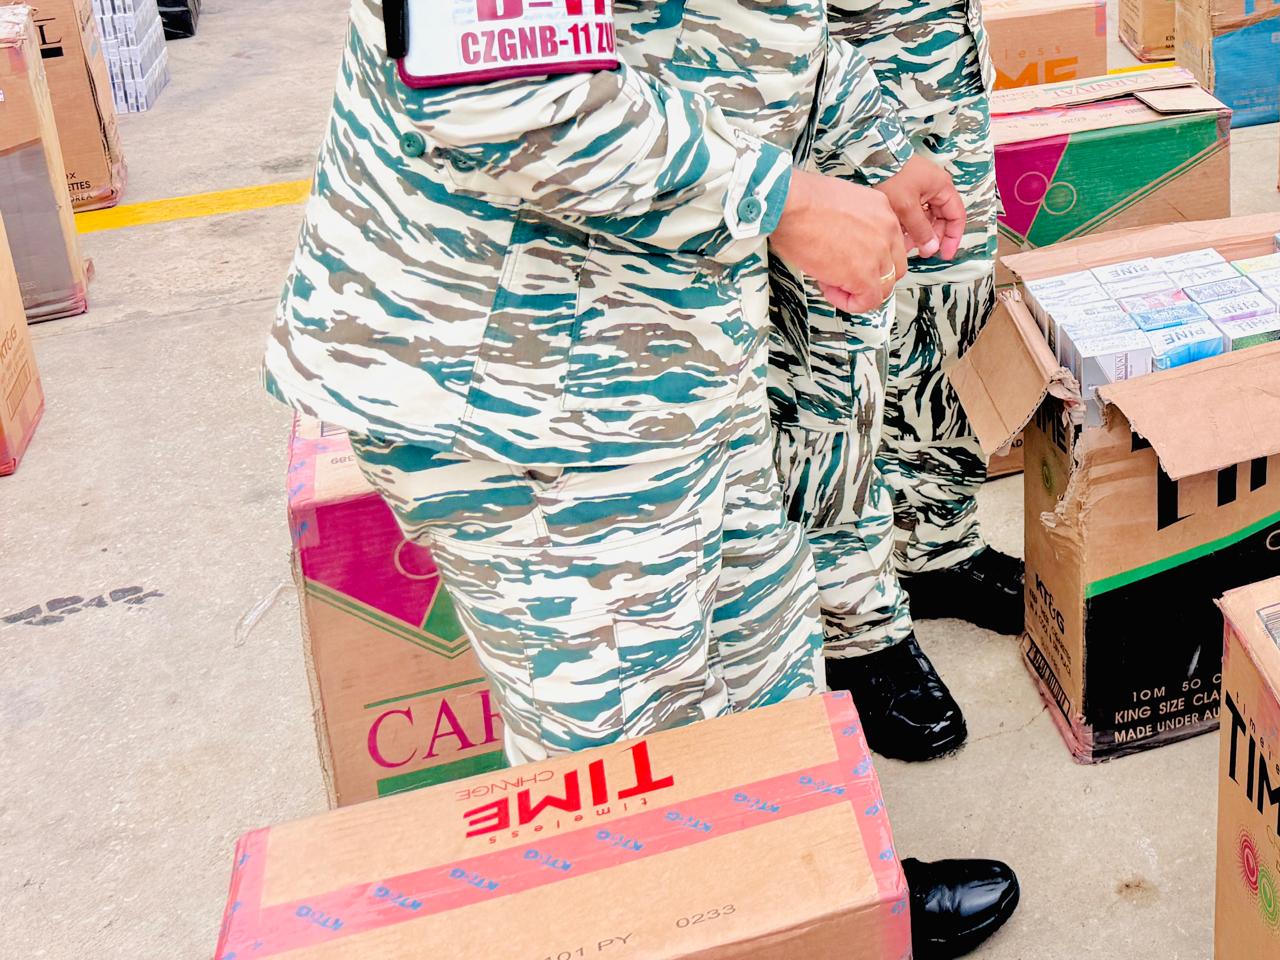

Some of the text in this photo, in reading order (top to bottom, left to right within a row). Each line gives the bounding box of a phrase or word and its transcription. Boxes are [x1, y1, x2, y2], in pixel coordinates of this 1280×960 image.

[460, 23, 593, 65] CZGNB-11
[1109, 264, 1150, 279] PINE
[1219, 299, 1260, 316] PINE
[1162, 327, 1207, 345] PINE
[1034, 573, 1066, 636] KT&G
[1132, 679, 1202, 702] 10M 50
[1114, 706, 1152, 725] KING
[1158, 697, 1186, 716] SIZE
[1192, 691, 1221, 707] CLA
[1114, 724, 1154, 744] MADE
[1156, 712, 1199, 730] UNDER
[455, 769, 555, 803] CHANGE
[463, 740, 675, 839] TIME
[488, 797, 648, 845] timeless
[597, 903, 737, 952] PY 0233
